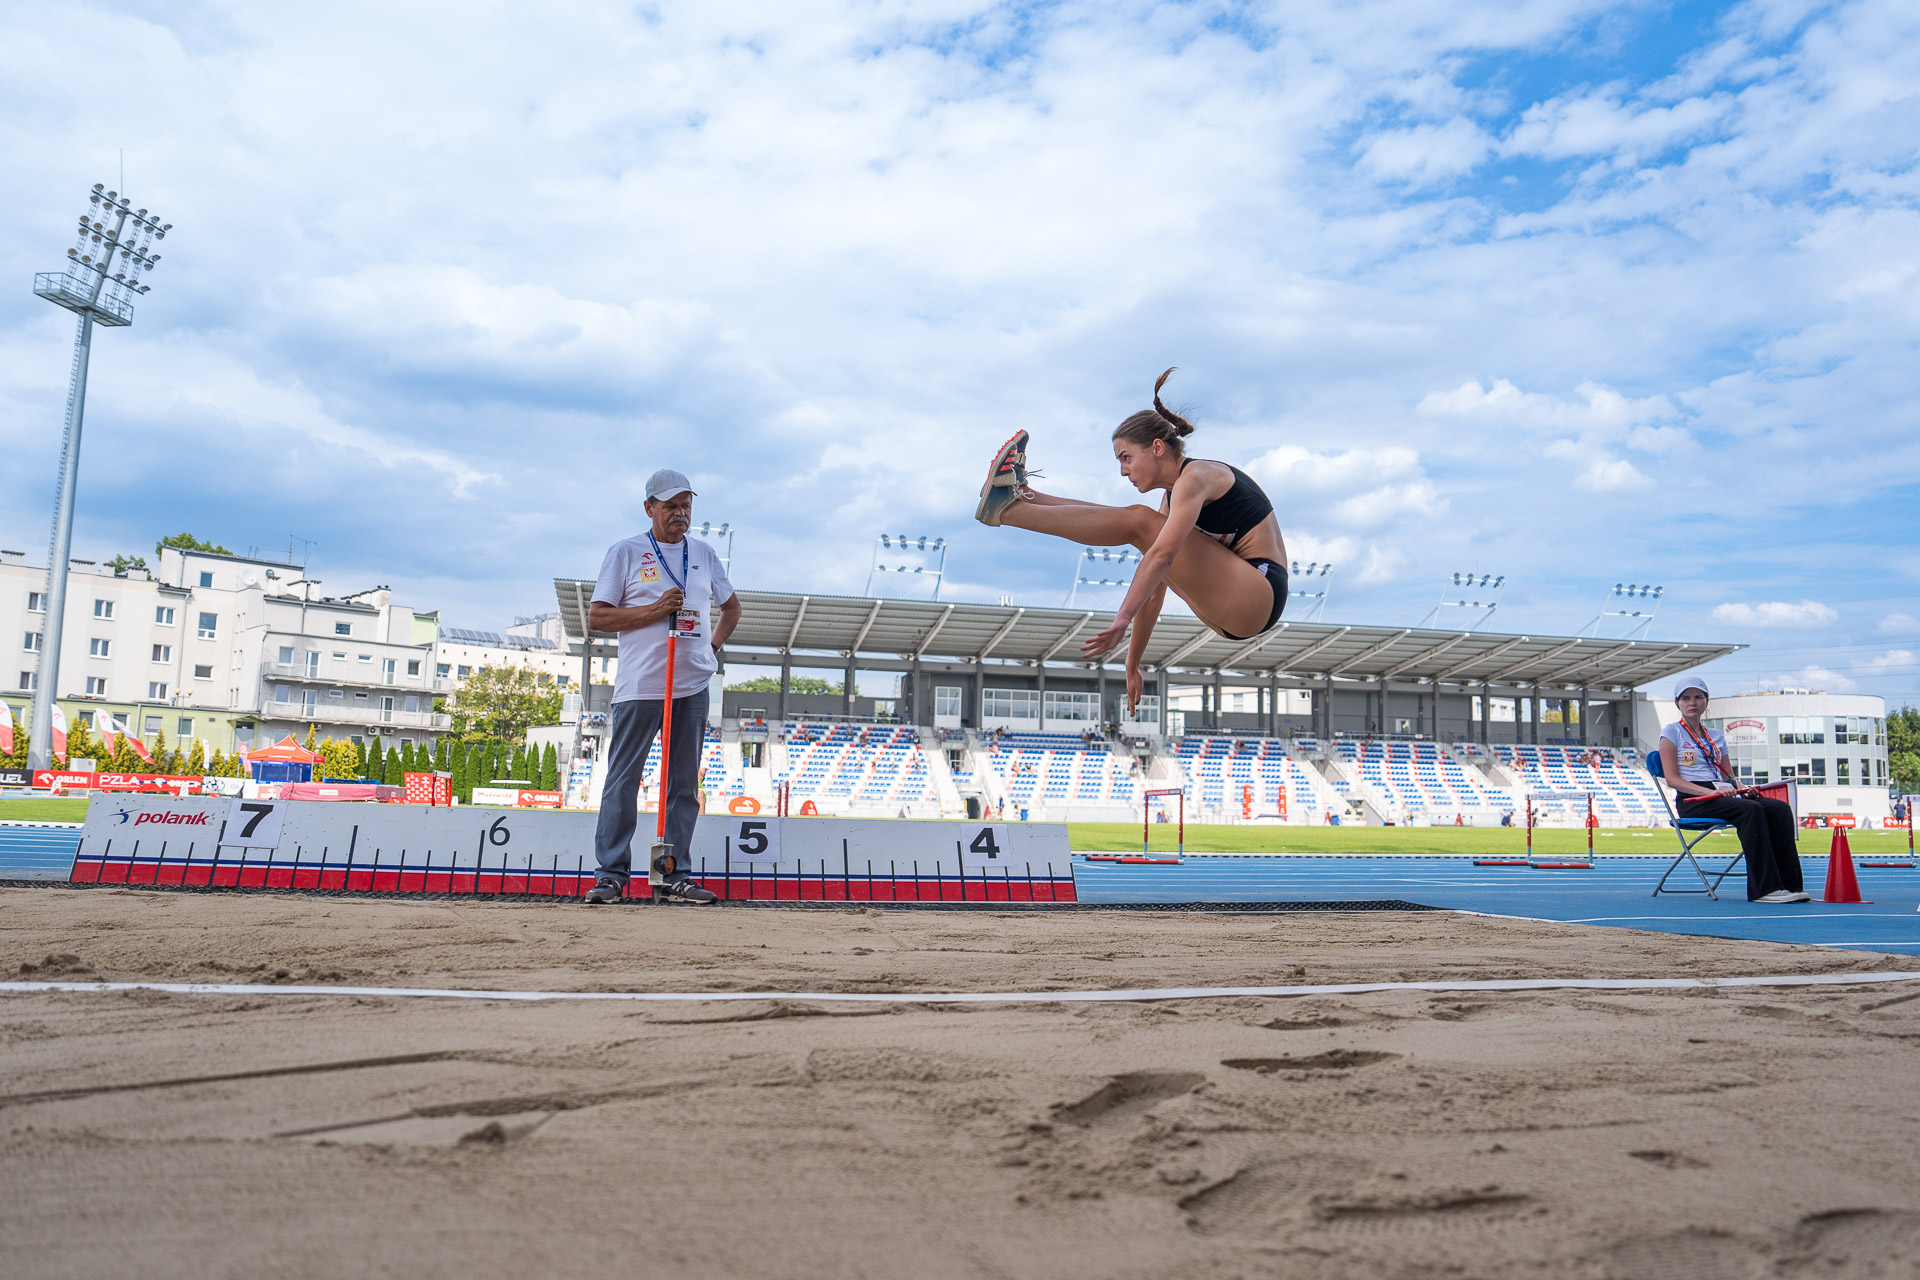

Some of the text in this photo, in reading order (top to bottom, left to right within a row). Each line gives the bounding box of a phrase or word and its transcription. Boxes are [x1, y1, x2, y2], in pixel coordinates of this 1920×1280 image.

[55, 775, 88, 784] ORLEN
[99, 775, 140, 785] PZLA
[534, 794, 560, 802] ORLEN
[134, 810, 209, 826] polanik
[240, 803, 275, 838] 7
[489, 815, 511, 846] 6
[738, 821, 769, 854] 5
[969, 827, 1000, 858] 4
